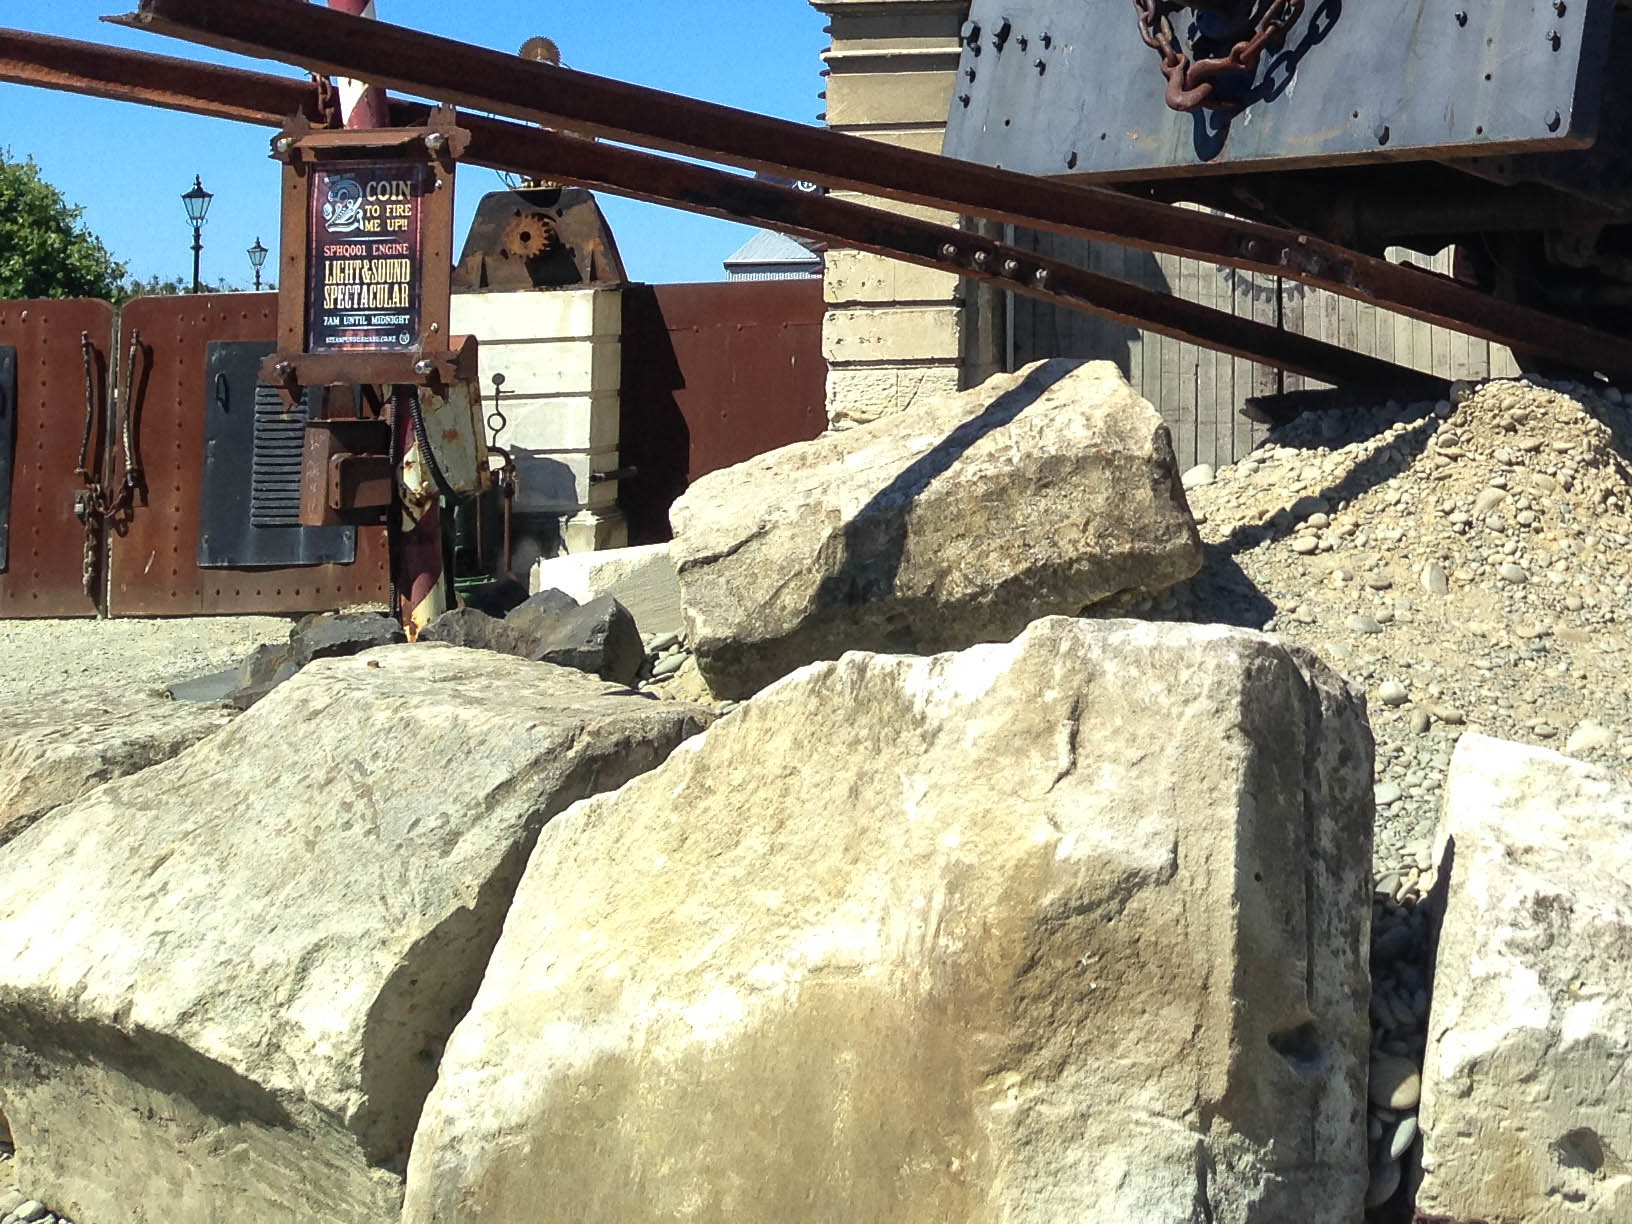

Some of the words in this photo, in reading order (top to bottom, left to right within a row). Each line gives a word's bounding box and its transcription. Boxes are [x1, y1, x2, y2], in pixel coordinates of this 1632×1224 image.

[365, 180, 411, 202] COIN
[364, 204, 381, 217] TO
[385, 203, 412, 217] FIRE
[364, 218, 381, 232] ME
[386, 218, 408, 231] UP!!
[323, 244, 367, 257] SPHQ001
[372, 243, 409, 255] ENGINE
[324, 258, 411, 284] LIGHT&SOUND
[323, 284, 410, 309] SPECTACULAR
[323, 316, 340, 326] 7AM
[343, 316, 368, 326] UNTIL
[371, 315, 410, 325] MIDNIGHT
